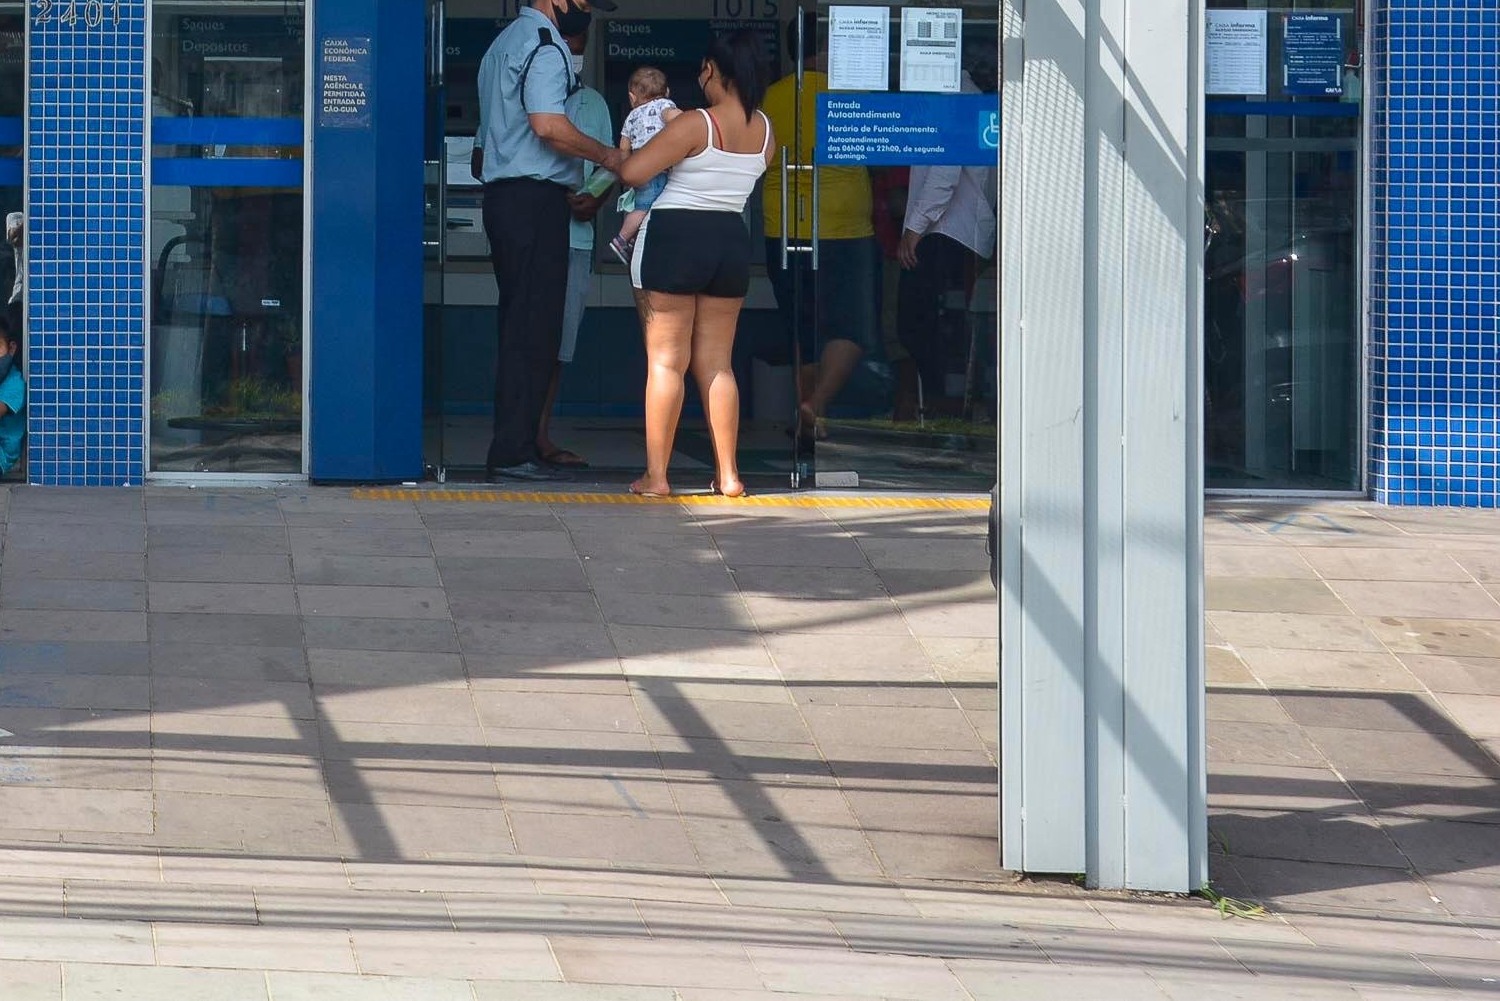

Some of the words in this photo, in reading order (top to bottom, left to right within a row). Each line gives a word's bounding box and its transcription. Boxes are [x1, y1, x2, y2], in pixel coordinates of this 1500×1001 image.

[182, 17, 225, 32] Saques
[608, 20, 651, 34] Saques
[324, 46, 367, 55] ECONÔMICA
[608, 43, 676, 58] Depósitos
[323, 74, 347, 82] NESTA
[324, 81, 358, 89] AGÊNCIA
[827, 100, 861, 109] Entrada
[827, 110, 901, 119] Autoatendimento
[827, 124, 859, 133] Horário
[861, 124, 871, 133] de
[873, 124, 938, 133] Funcionamento:
[876, 145, 902, 153] 22h00,
[903, 145, 913, 153] de
[914, 145, 945, 155] segunda
[834, 152, 868, 161] domingo.
